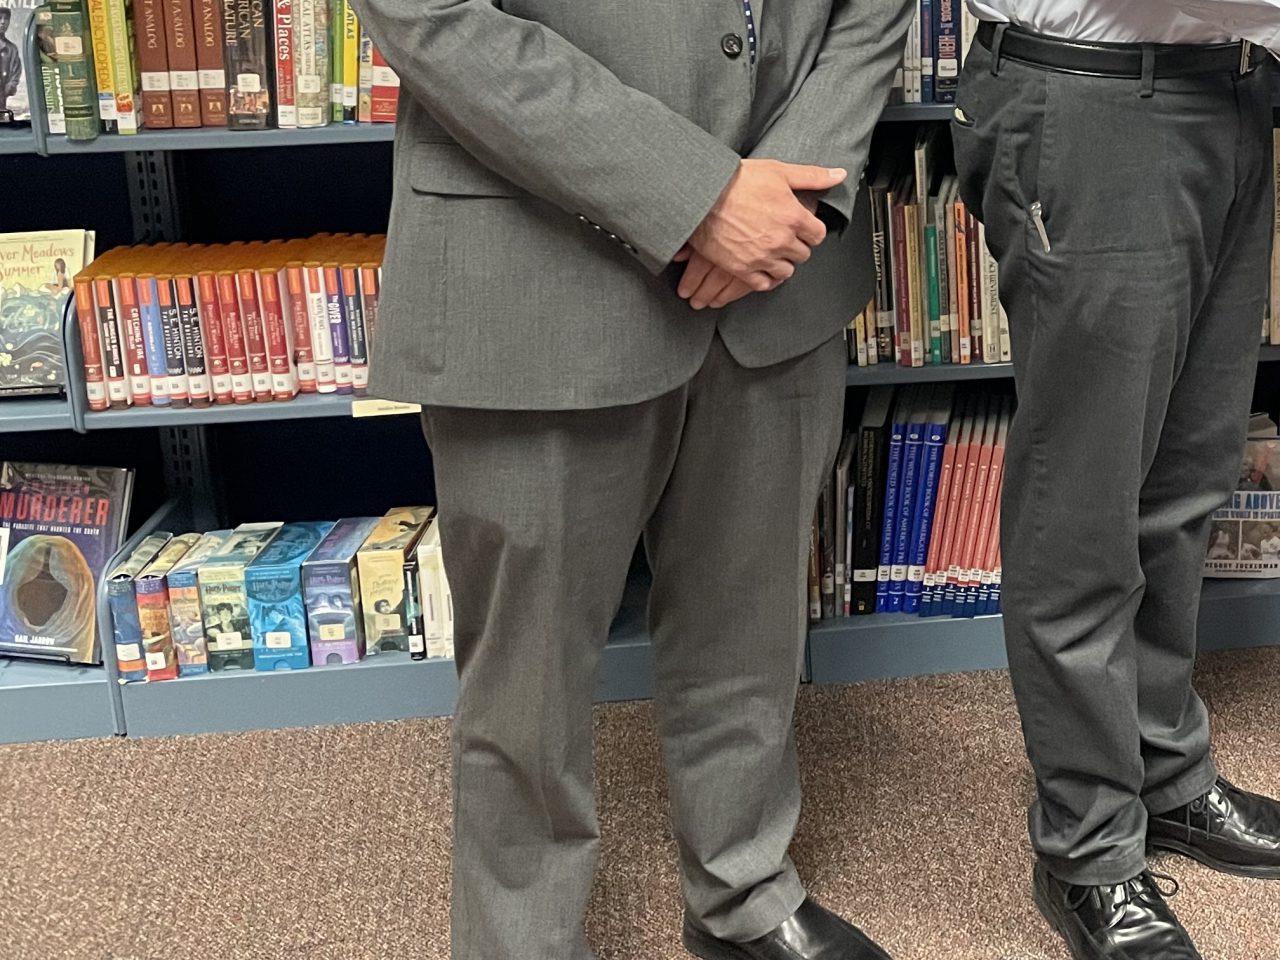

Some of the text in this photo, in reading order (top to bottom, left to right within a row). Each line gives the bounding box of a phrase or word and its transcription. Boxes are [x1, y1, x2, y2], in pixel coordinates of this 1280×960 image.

[145, 7, 157, 48] ANALOG
[203, 7, 214, 47] ANALOG
[278, 13, 292, 60] Places
[302, 21, 312, 51] ATLAS
[346, 12, 355, 39] ATLAS
[92, 15, 110, 90] ENCYCLOPEDIA
[939, 36, 956, 58] HERO
[23, 243, 75, 263] Meadows
[990, 261, 998, 315] ACHIEVEMENT
[328, 302, 341, 324] GIVER
[131, 308, 145, 360] CATCHING FIRE
[168, 309, 181, 359] S.E. HINTON
[189, 307, 203, 358] S.E. HINTON
[890, 462, 898, 486] WORLD
[0, 493, 110, 526] MURDERER
[887, 509, 893, 517] OF
